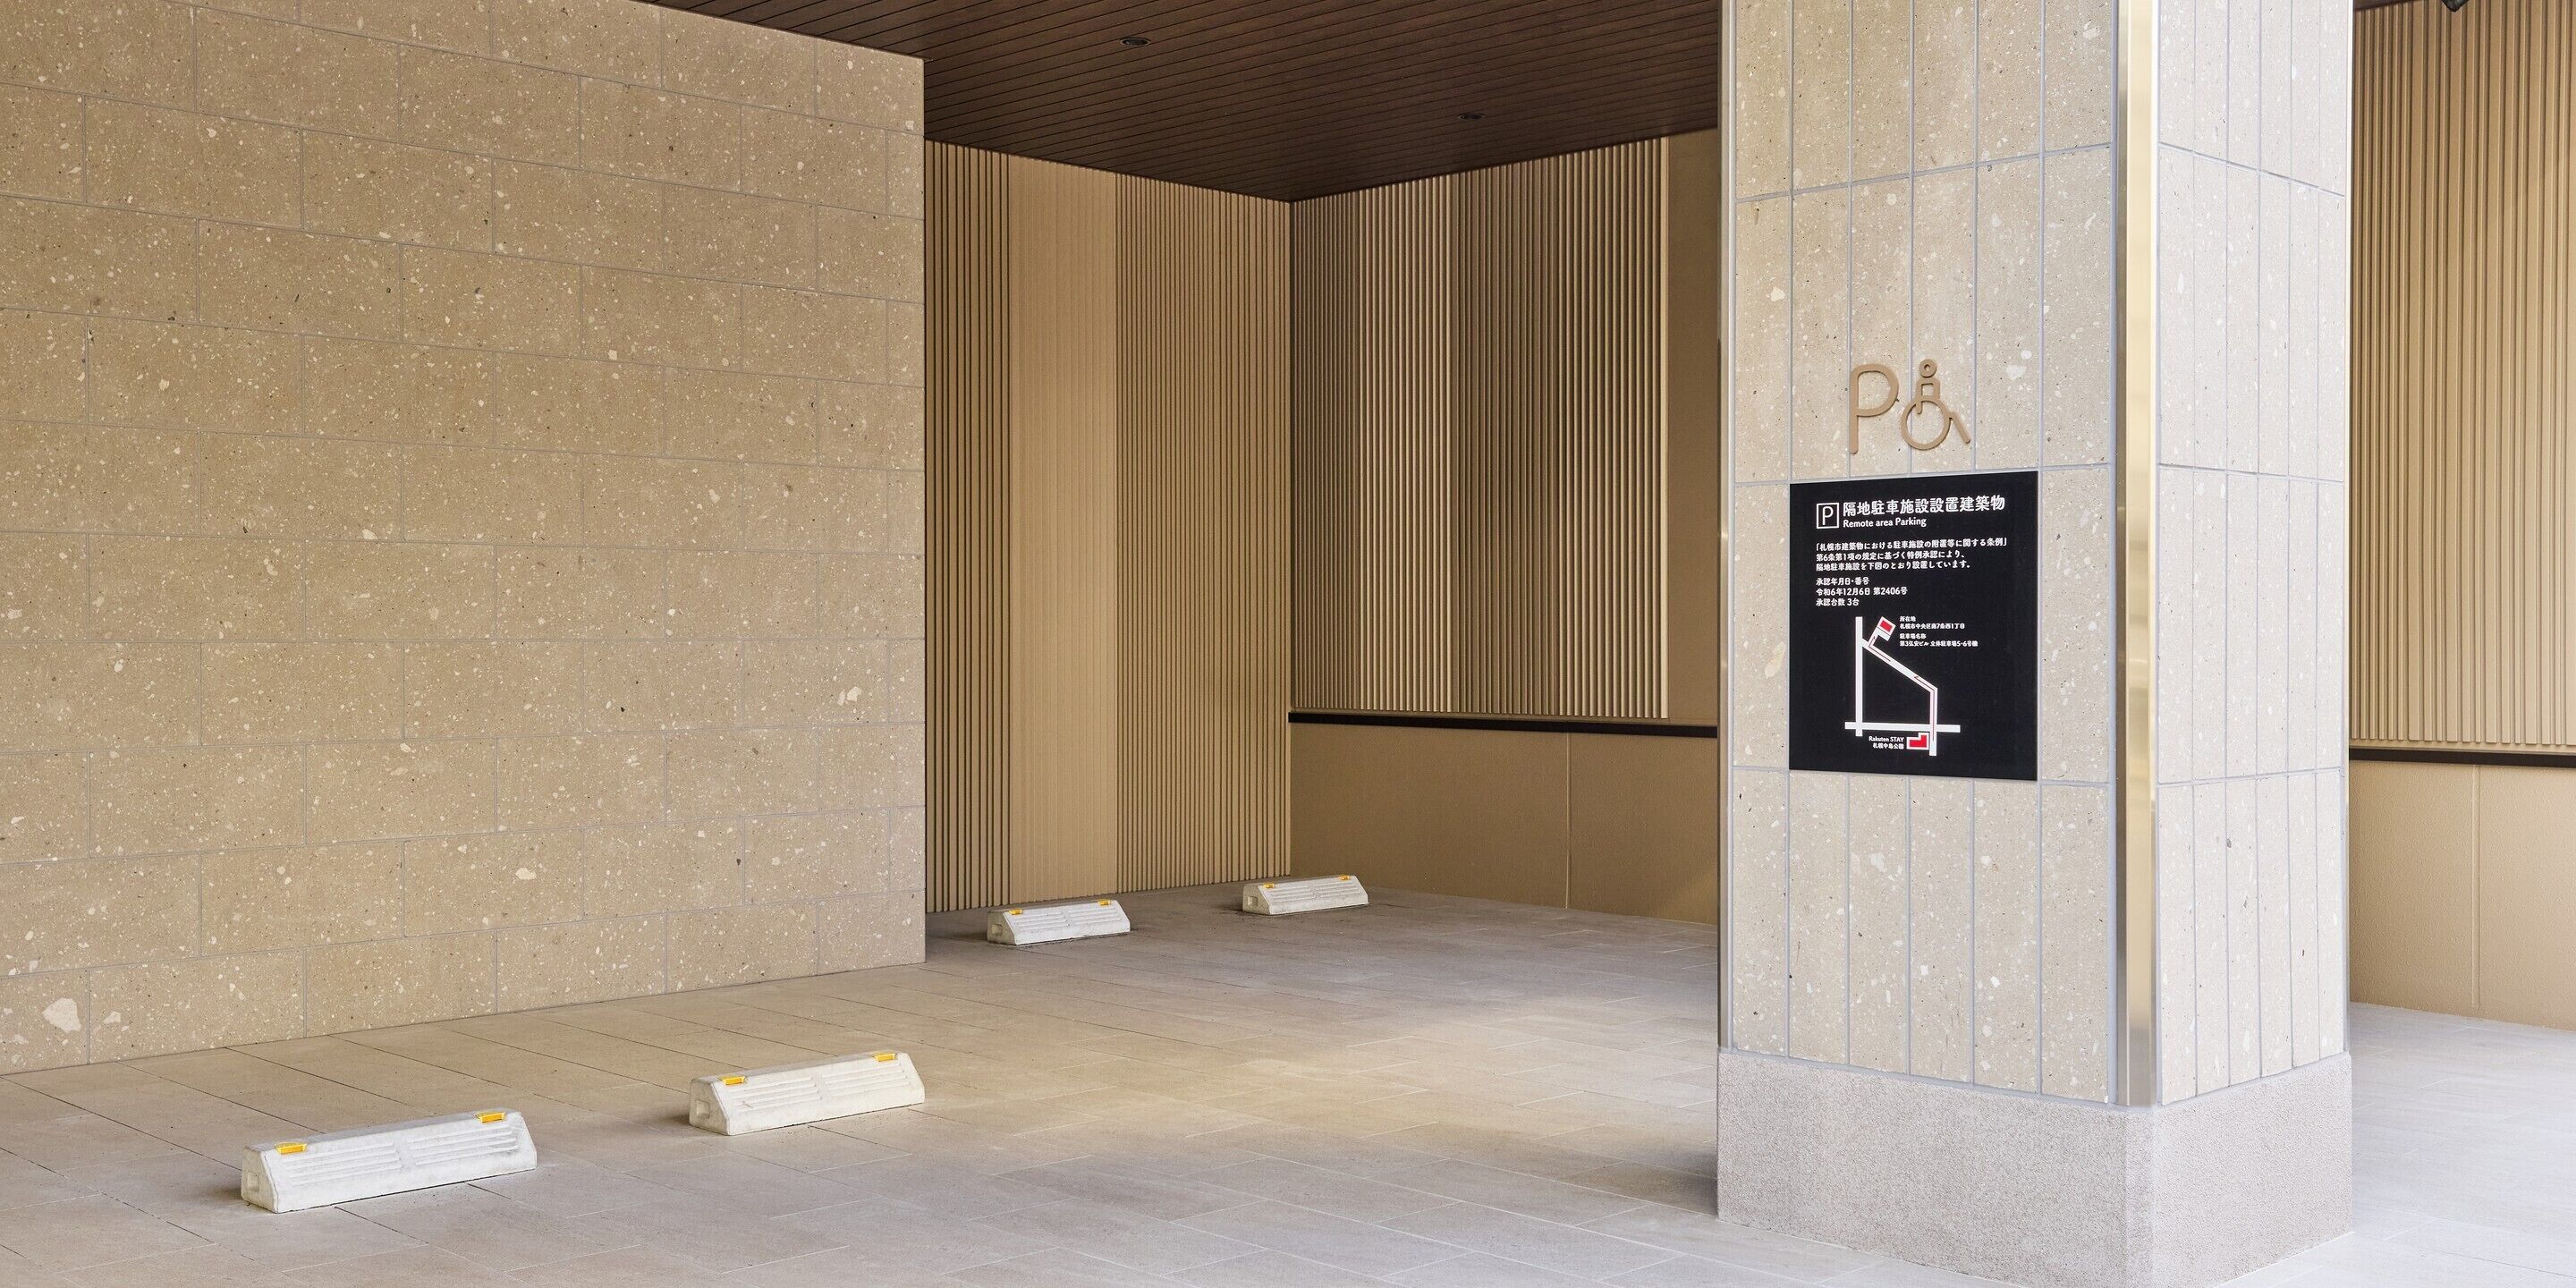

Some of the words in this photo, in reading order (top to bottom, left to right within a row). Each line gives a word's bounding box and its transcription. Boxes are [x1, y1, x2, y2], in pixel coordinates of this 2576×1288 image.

[1850, 363, 1899, 454] P
[1843, 495, 2005, 517] 隔地駐車施設設置建築物
[1822, 505, 1834, 526] P
[1843, 519, 1874, 528] Remote
[1876, 519, 1894, 527] area
[1895, 517, 1927, 528] Parking
[1816, 538, 2007, 552] 「札幌市建築物における駐車施設の附置等に関する条例」
[1816, 549, 1965, 562] 第6条第1項の規定に基づく特例承認により、
[1816, 560, 1970, 572] 隔地駐車施設を下図のとおり設置しています。
[1816, 588, 1870, 597] 令和6年12月6日
[1873, 586, 1908, 596] 第2406号
[1816, 597, 1845, 606] 承認台数
[1846, 597, 1860, 606] 3台
